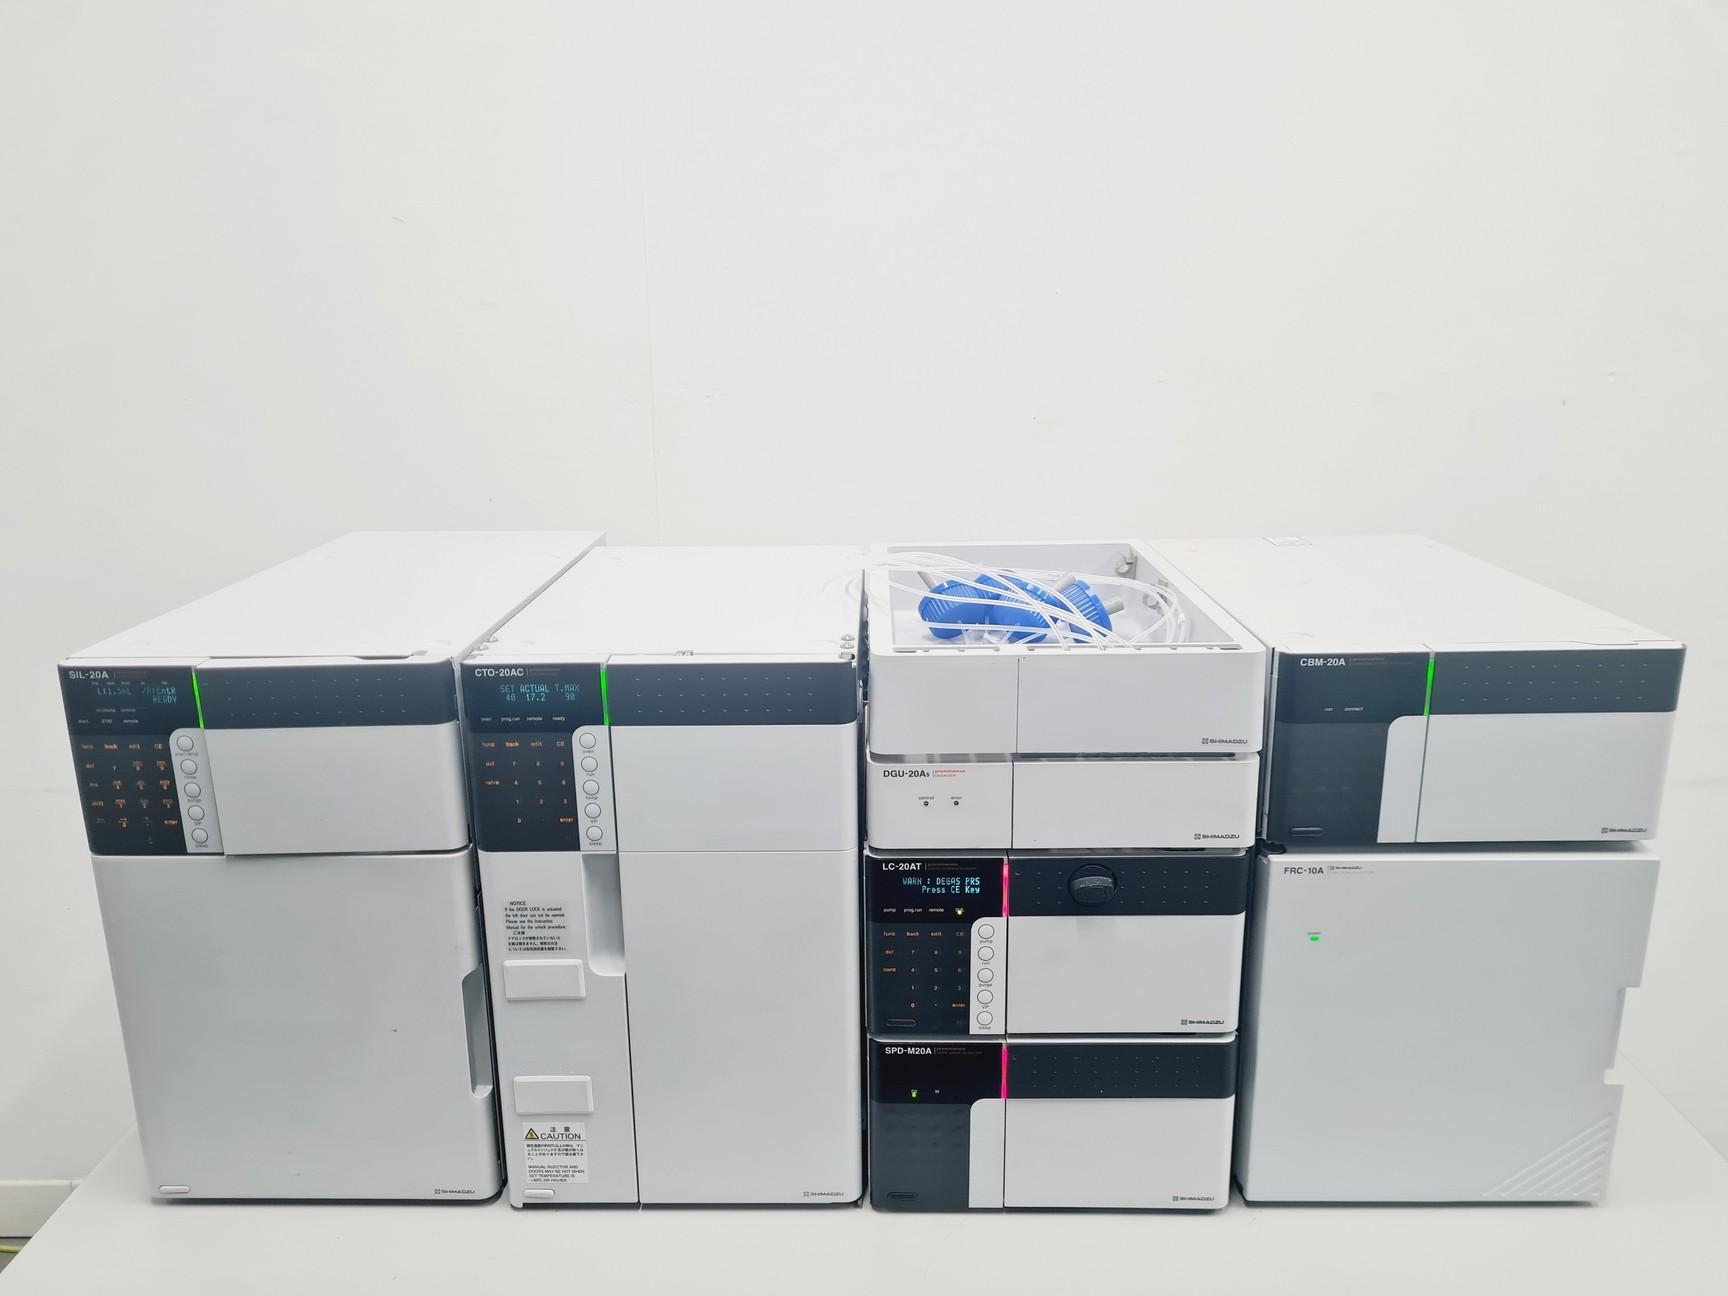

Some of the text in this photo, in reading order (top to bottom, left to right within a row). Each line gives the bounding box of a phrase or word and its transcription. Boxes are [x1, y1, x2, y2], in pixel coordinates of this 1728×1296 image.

[1300, 658, 1346, 667] CBM-20A
[68, 670, 109, 679] SIL-20A
[474, 668, 524, 677] CTO-20AC
[500, 684, 580, 693] SET ACTUAL T.MAX
[526, 693, 546, 702] 17.2
[882, 862, 922, 871] LC-20AT
[1284, 867, 1324, 875] FRC-10A
[902, 877, 922, 885] WARN
[936, 877, 960, 885] DEGAS
[965, 877, 980, 885] PRS
[921, 885, 980, 894] Press CE Key
[885, 1047, 932, 1055] SPD-M20A
